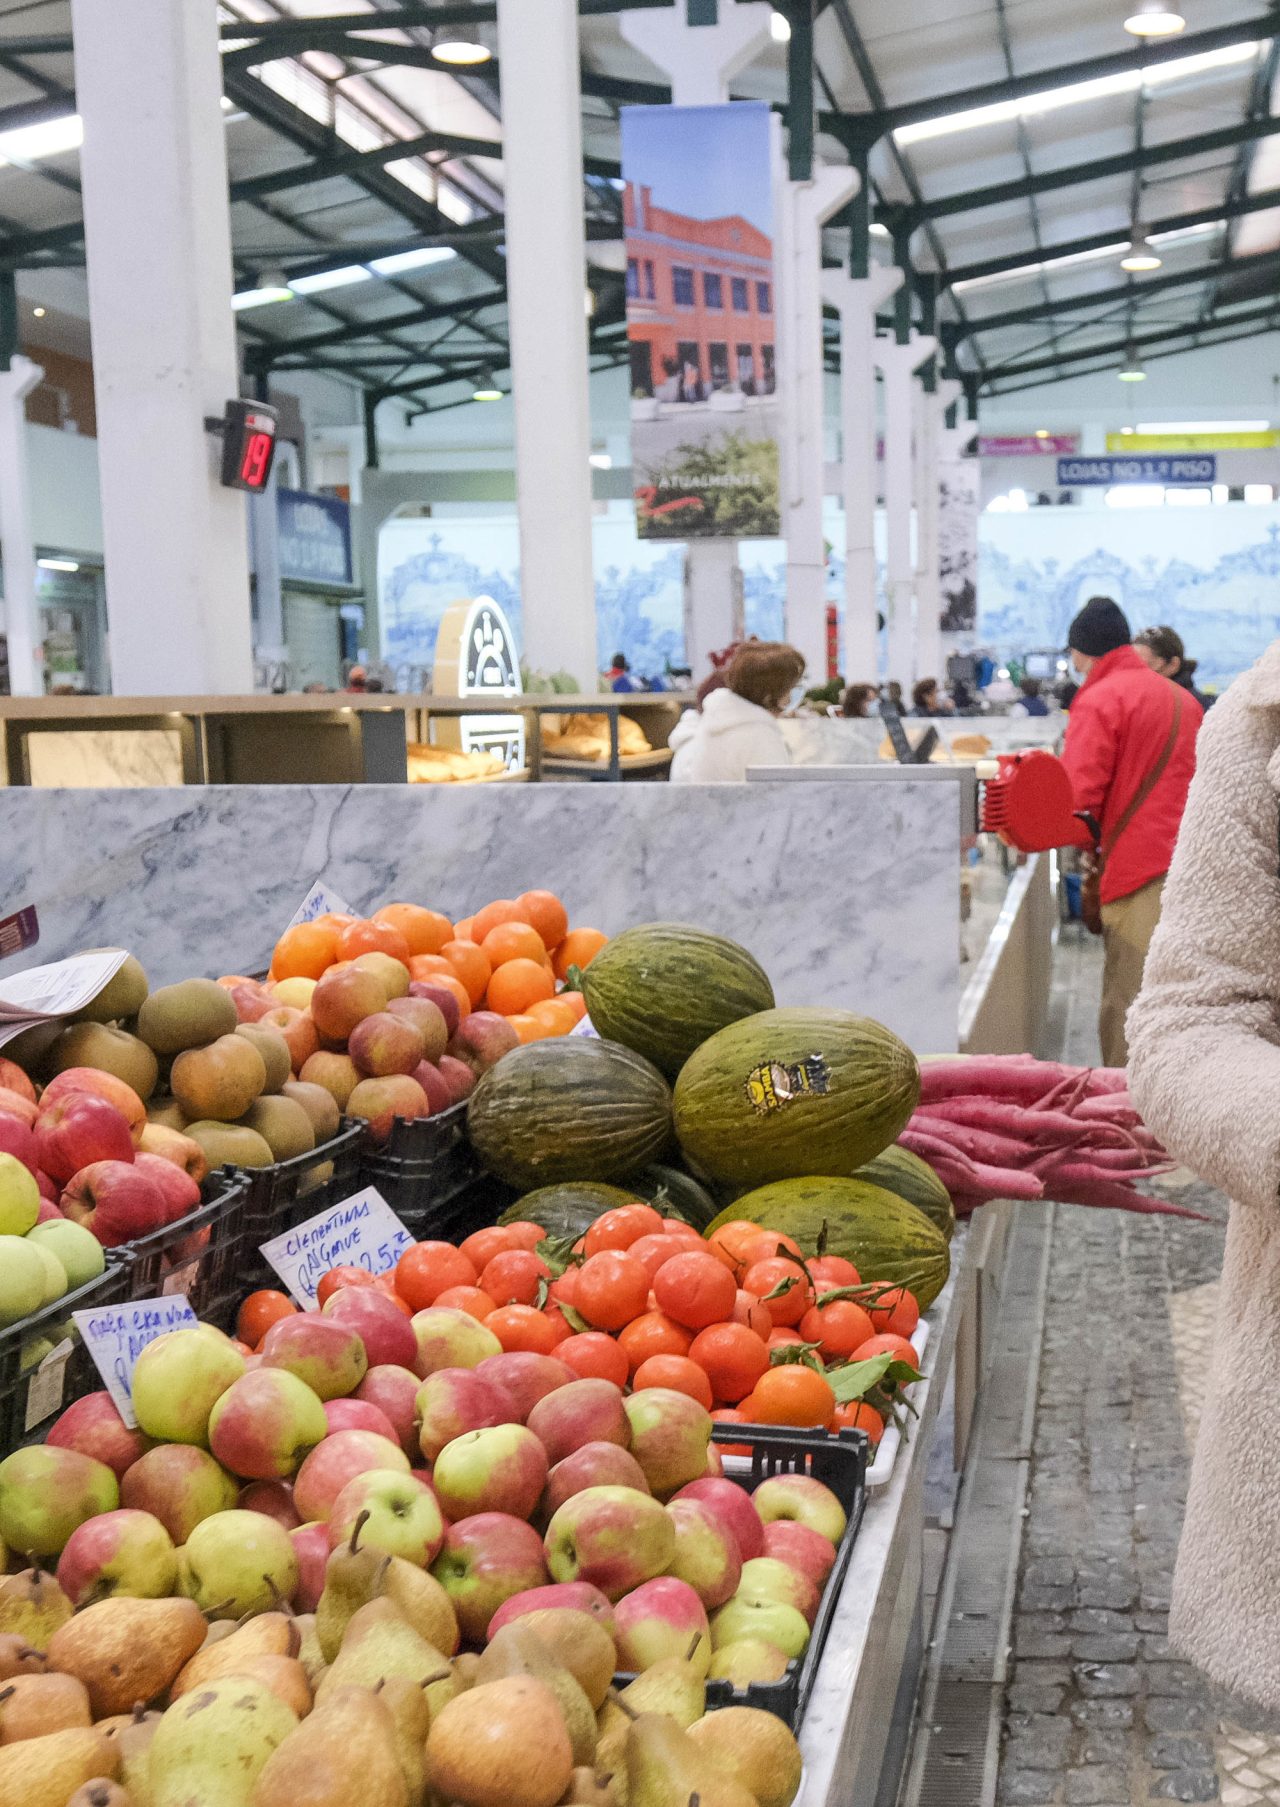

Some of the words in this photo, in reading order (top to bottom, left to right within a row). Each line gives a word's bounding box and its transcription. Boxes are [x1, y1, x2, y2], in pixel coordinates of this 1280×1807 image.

[1059, 463, 1110, 480] LOJAS
[1113, 462, 1141, 480] NO
[1172, 460, 1213, 478] PISO
[760, 1065, 778, 1108] SAMBA
